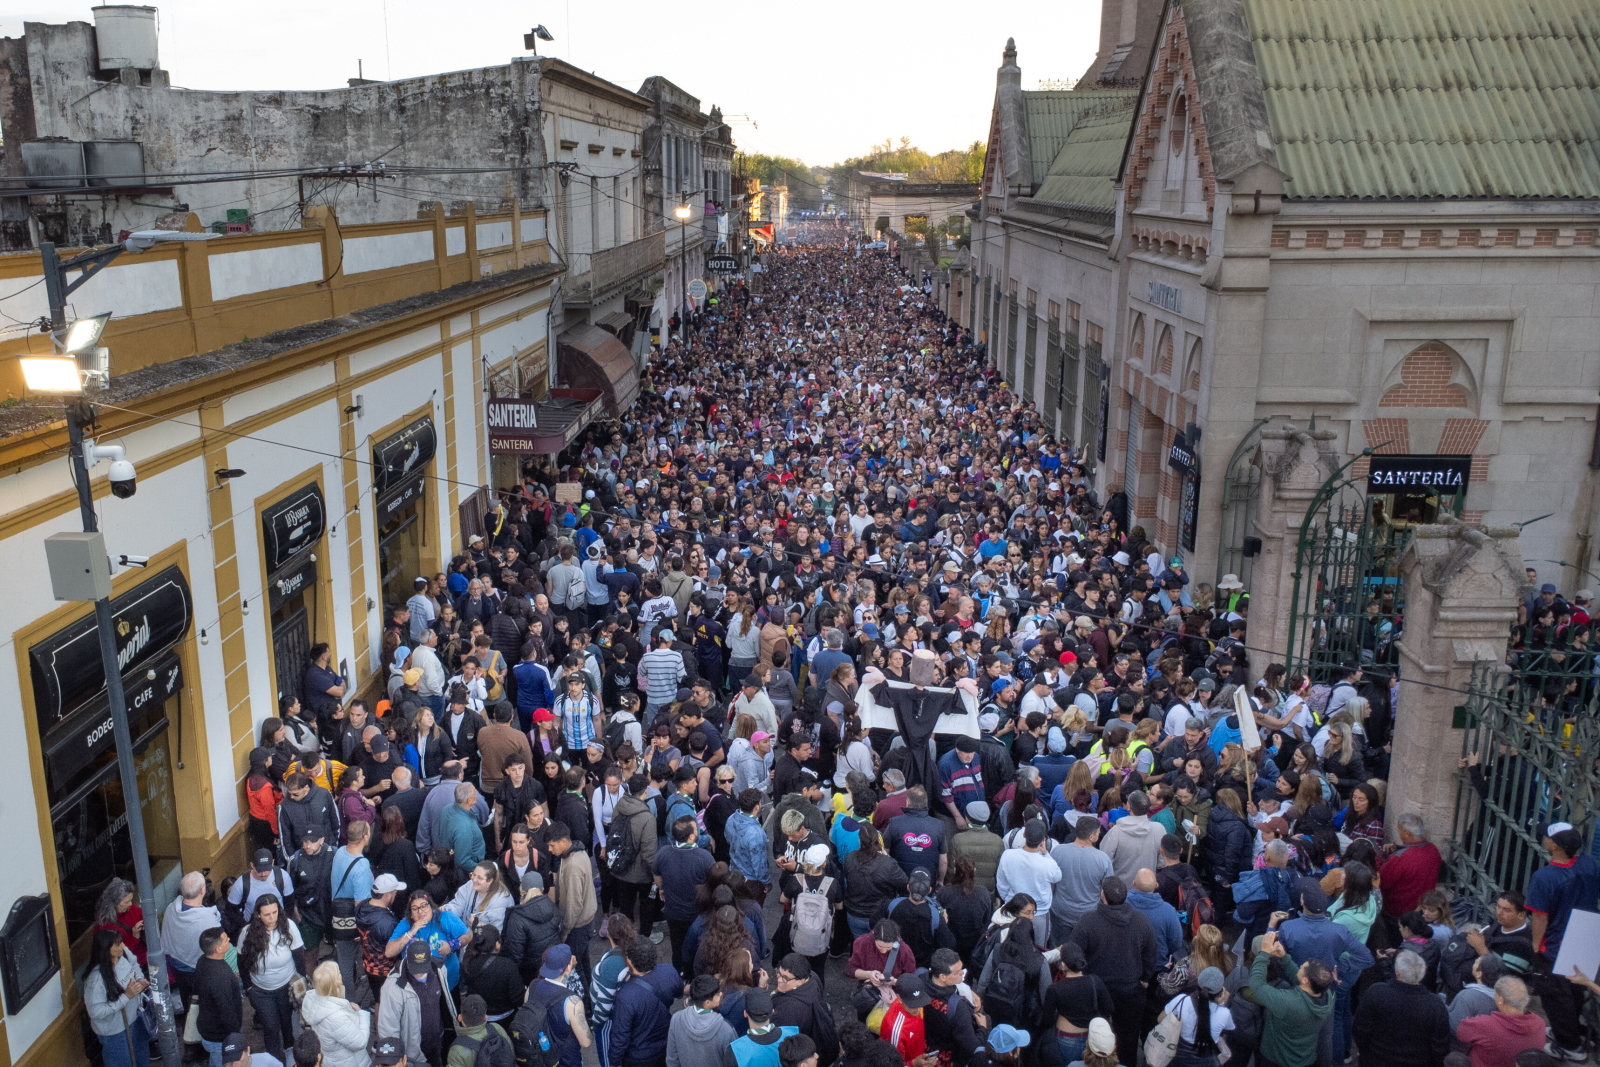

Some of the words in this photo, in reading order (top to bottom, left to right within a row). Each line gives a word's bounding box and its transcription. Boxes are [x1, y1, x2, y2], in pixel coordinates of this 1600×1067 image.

[708, 260, 737, 269] HOTEL
[488, 403, 537, 428] SANTERIA
[491, 438, 534, 450] SANTERIA
[1372, 468, 1464, 486] SANTERÍA
[87, 717, 114, 748] BODEG
[134, 686, 153, 706] CAFE
